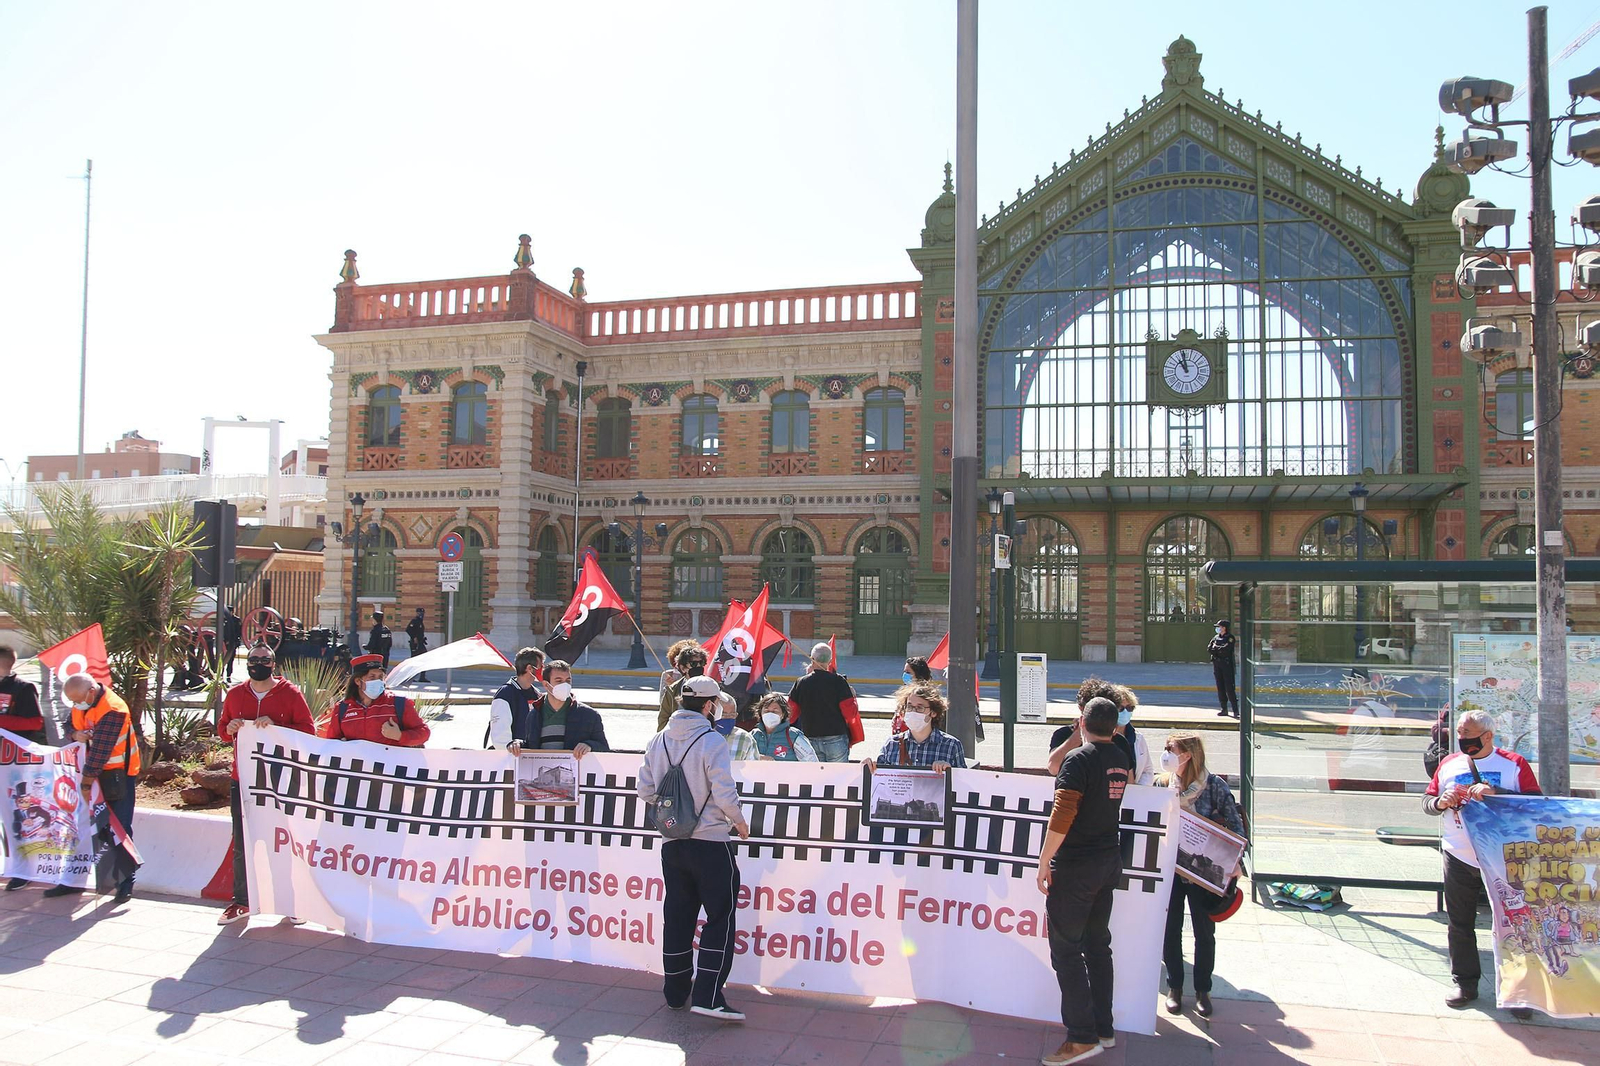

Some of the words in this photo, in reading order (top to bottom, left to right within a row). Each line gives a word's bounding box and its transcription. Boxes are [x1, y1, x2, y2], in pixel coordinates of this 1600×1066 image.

[1535, 824, 1576, 840] POR
[1584, 827, 1600, 840] U
[1503, 840, 1600, 861] FERROCAR
[442, 856, 618, 898] Almeriense
[625, 875, 664, 902] en
[736, 884, 817, 914] ensa
[827, 883, 886, 920] del
[897, 888, 1049, 940] Ferroca
[1523, 879, 1600, 902] SOCI
[432, 895, 558, 940] Público,
[567, 906, 655, 945] Social
[692, 920, 885, 966] stenible
